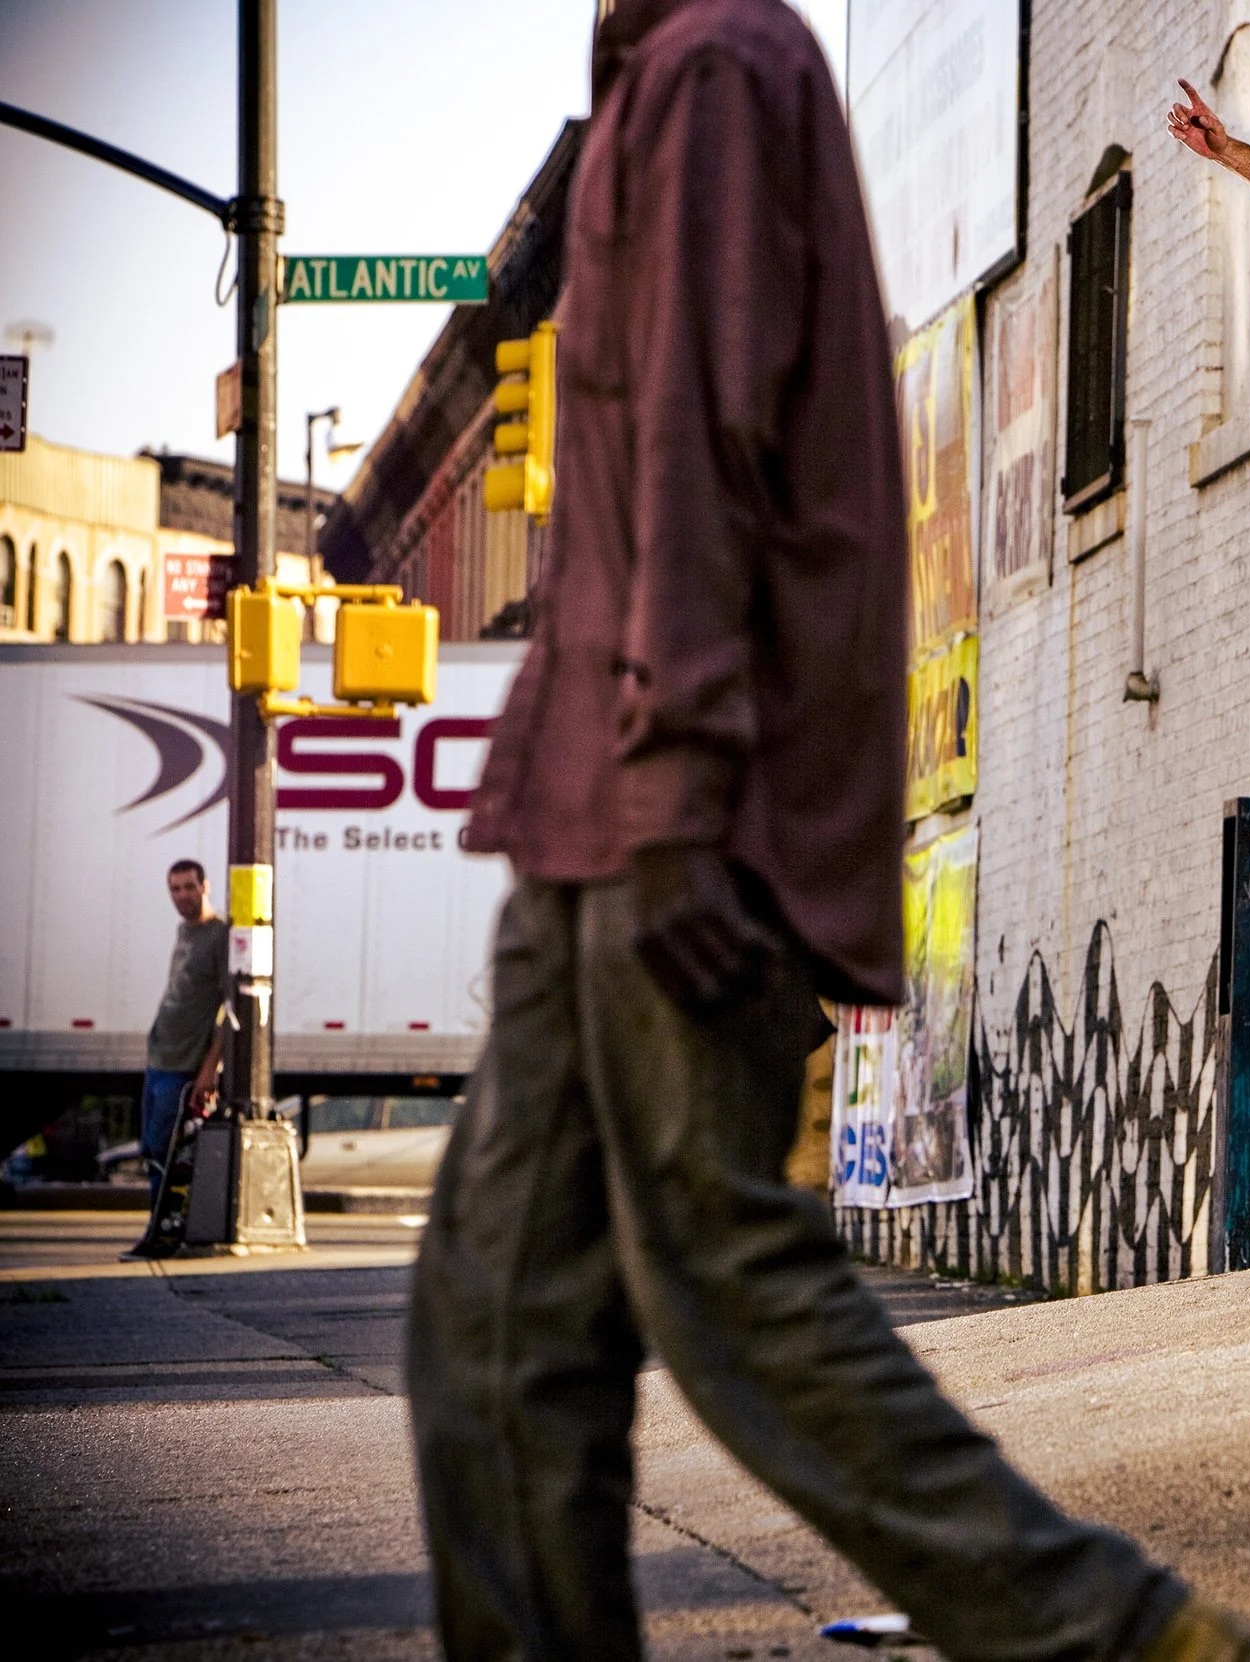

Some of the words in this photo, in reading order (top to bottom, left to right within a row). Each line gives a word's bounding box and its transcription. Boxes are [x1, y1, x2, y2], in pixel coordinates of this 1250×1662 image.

[290, 258, 448, 298] ATLANTIC
[453, 260, 480, 279] AV
[275, 827, 328, 850] The
[342, 826, 443, 851] Select
